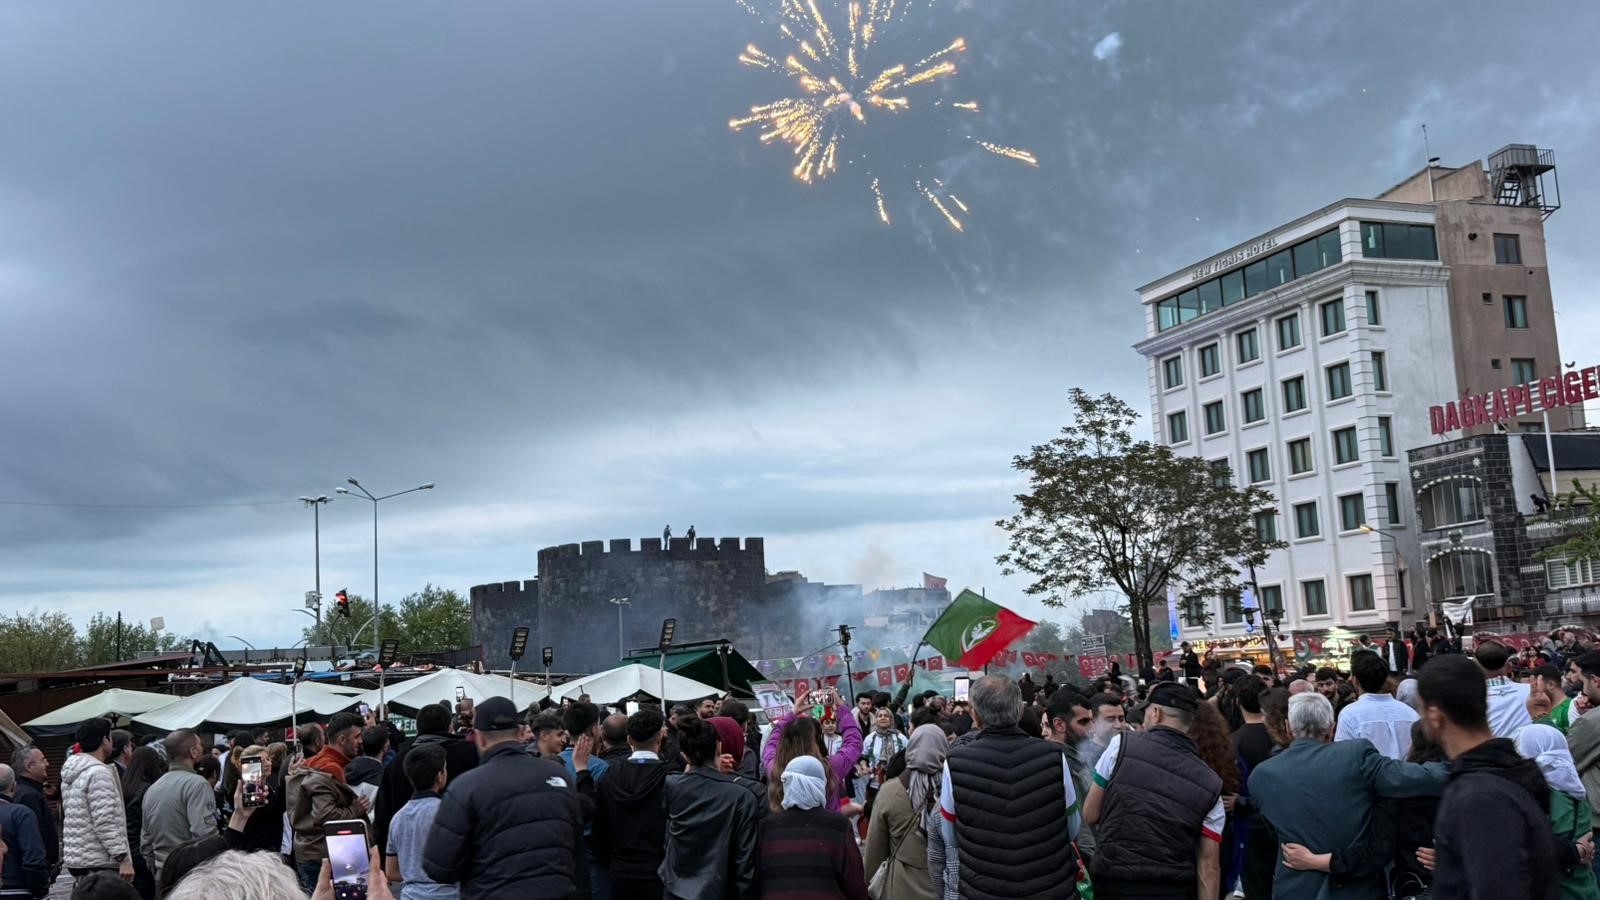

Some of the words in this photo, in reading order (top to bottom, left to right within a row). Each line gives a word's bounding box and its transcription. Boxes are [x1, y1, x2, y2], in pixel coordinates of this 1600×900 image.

[1192, 264, 1212, 280] NEW
[1214, 250, 1244, 272] TIGRIS
[1245, 237, 1278, 257] HOTEL
[1539, 361, 1600, 410] CİĞE
